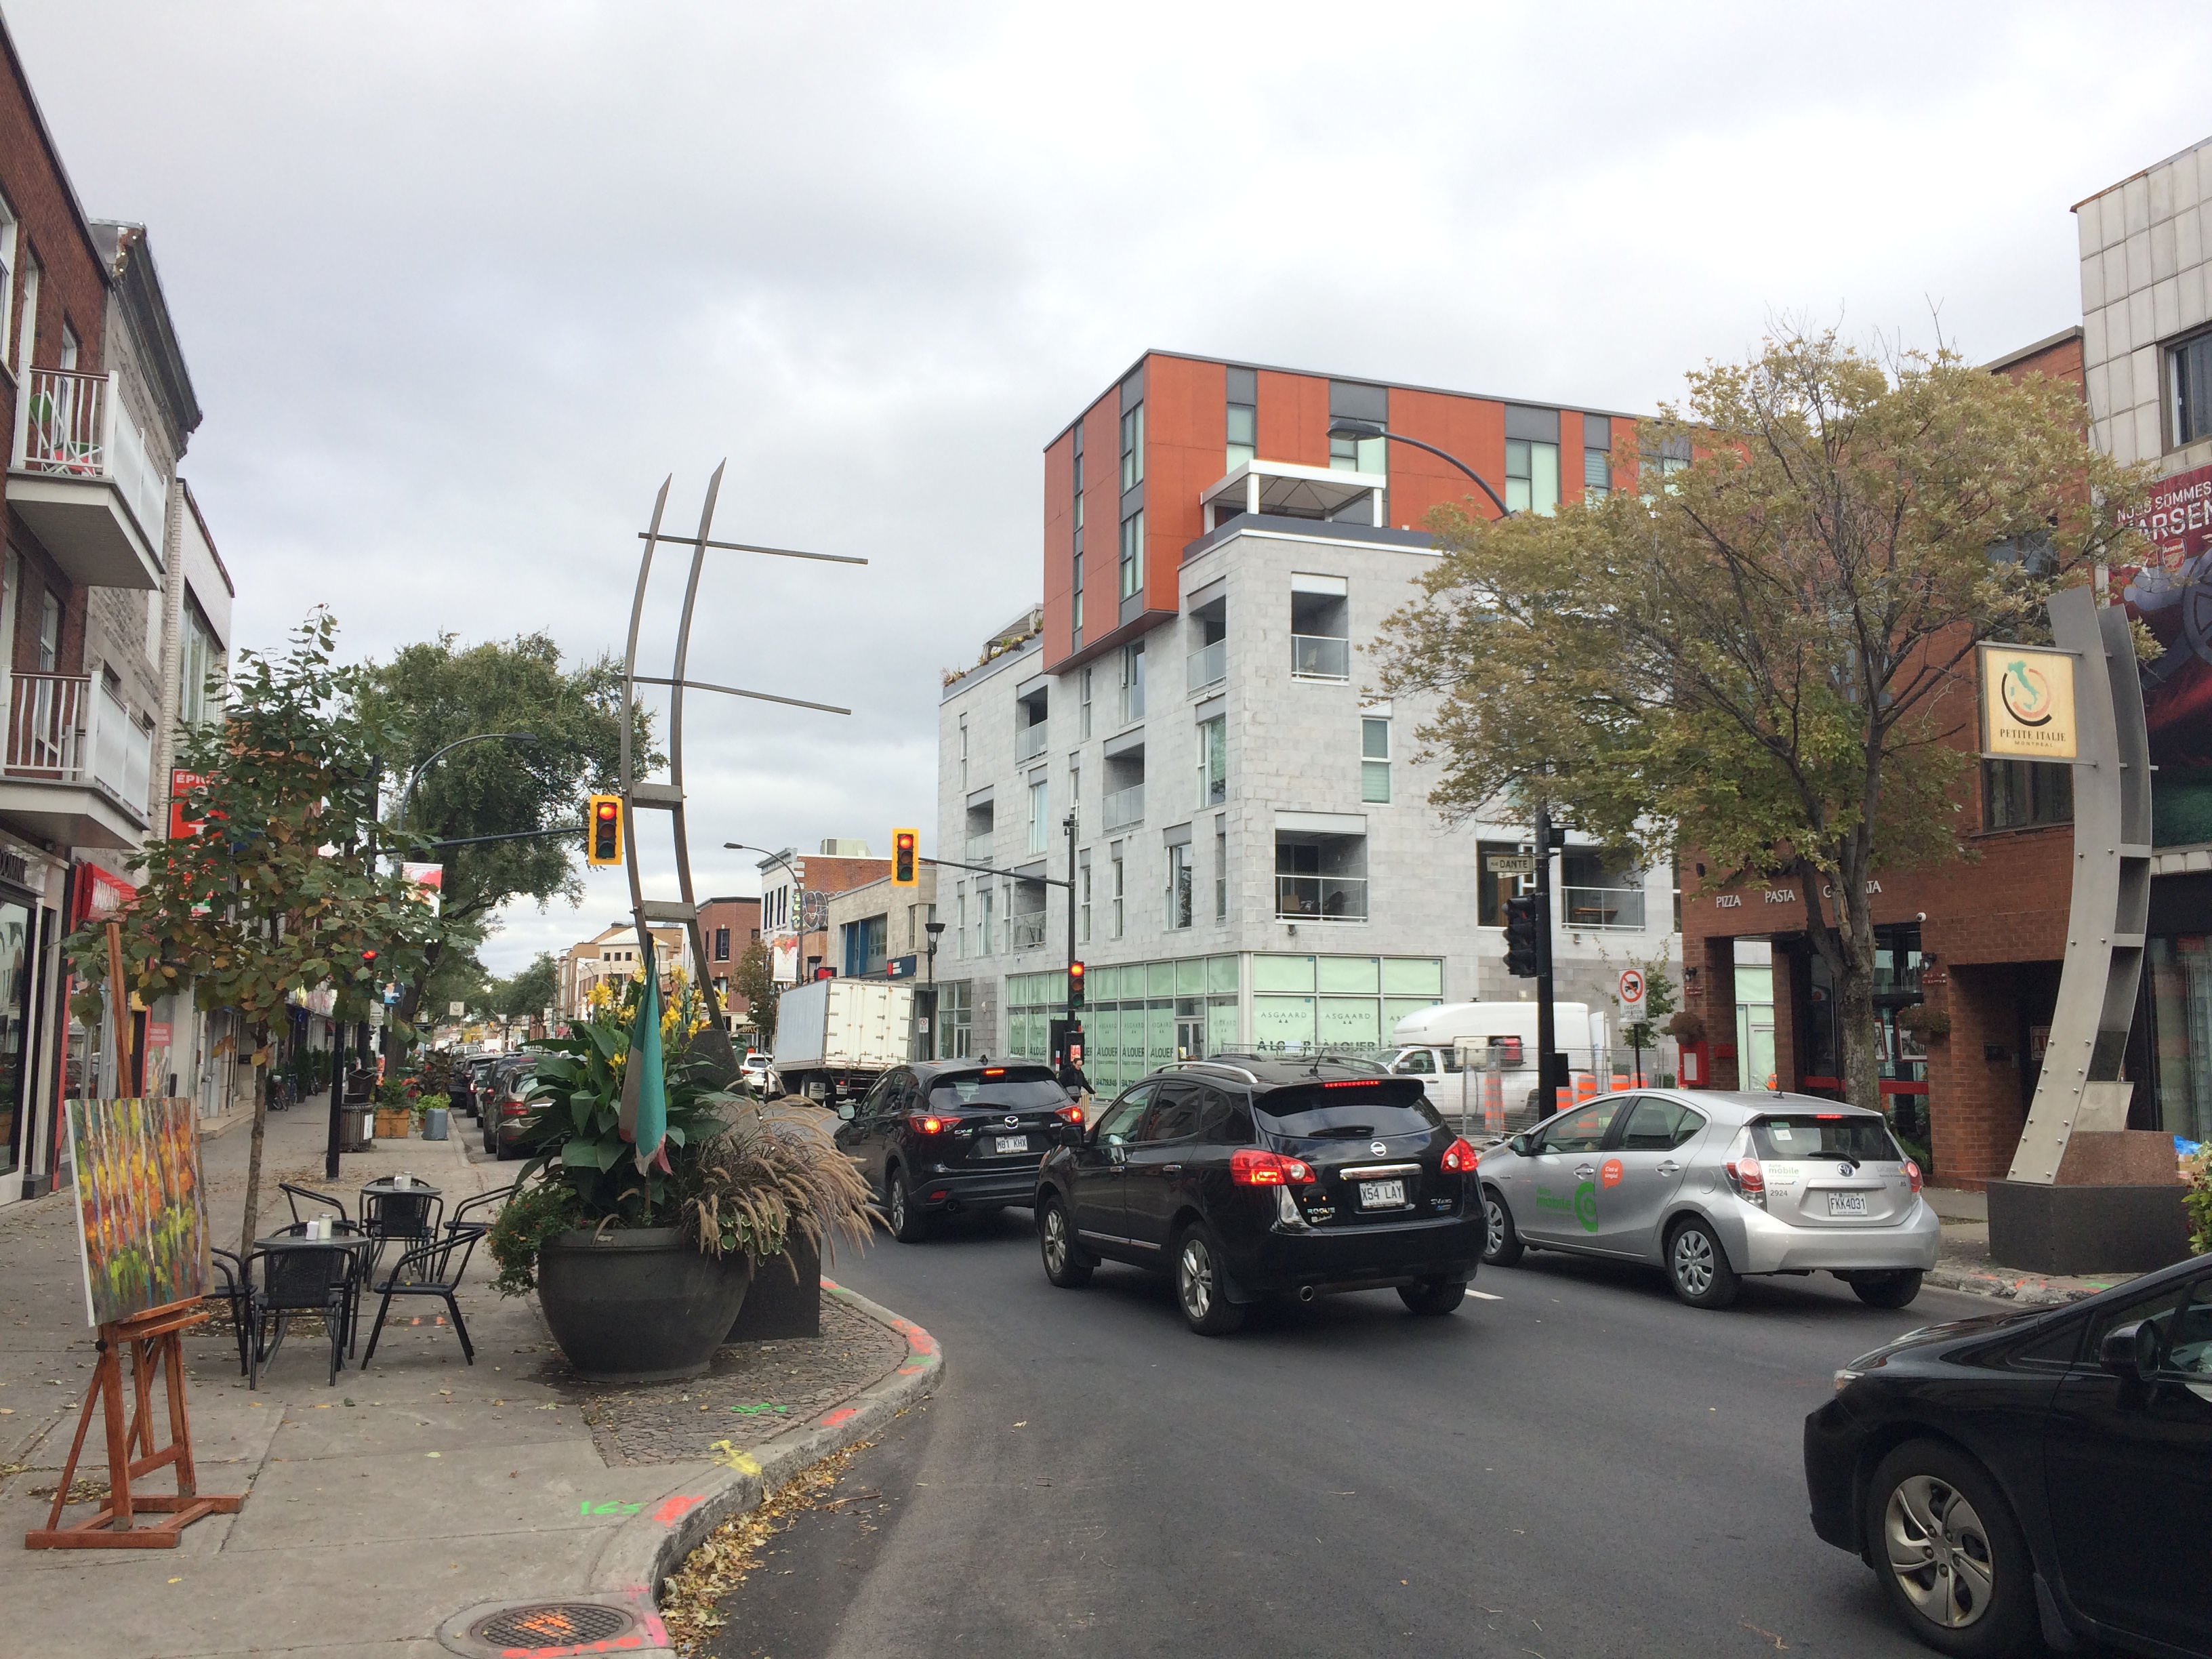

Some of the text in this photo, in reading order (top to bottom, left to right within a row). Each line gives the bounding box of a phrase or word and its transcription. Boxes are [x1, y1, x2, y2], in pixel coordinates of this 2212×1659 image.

[2117, 481, 2211, 523] NOS SOMMES
[2163, 543, 2183, 553] Arsenal
[2000, 729, 2066, 741] PETITE ITALIE
[1500, 860, 1528, 868] DANTE
[1716, 889, 1796, 908] PIZZA PASTA
[1257, 1038, 1311, 1051] À LOR
[1127, 1047, 1145, 1057] LOUER
[998, 1138, 1027, 1149] M81 KHX
[1361, 1185, 1402, 1201] X54 LAY
[1536, 1195, 1572, 1210] mobile
[1830, 1197, 1865, 1210] FKK4031
